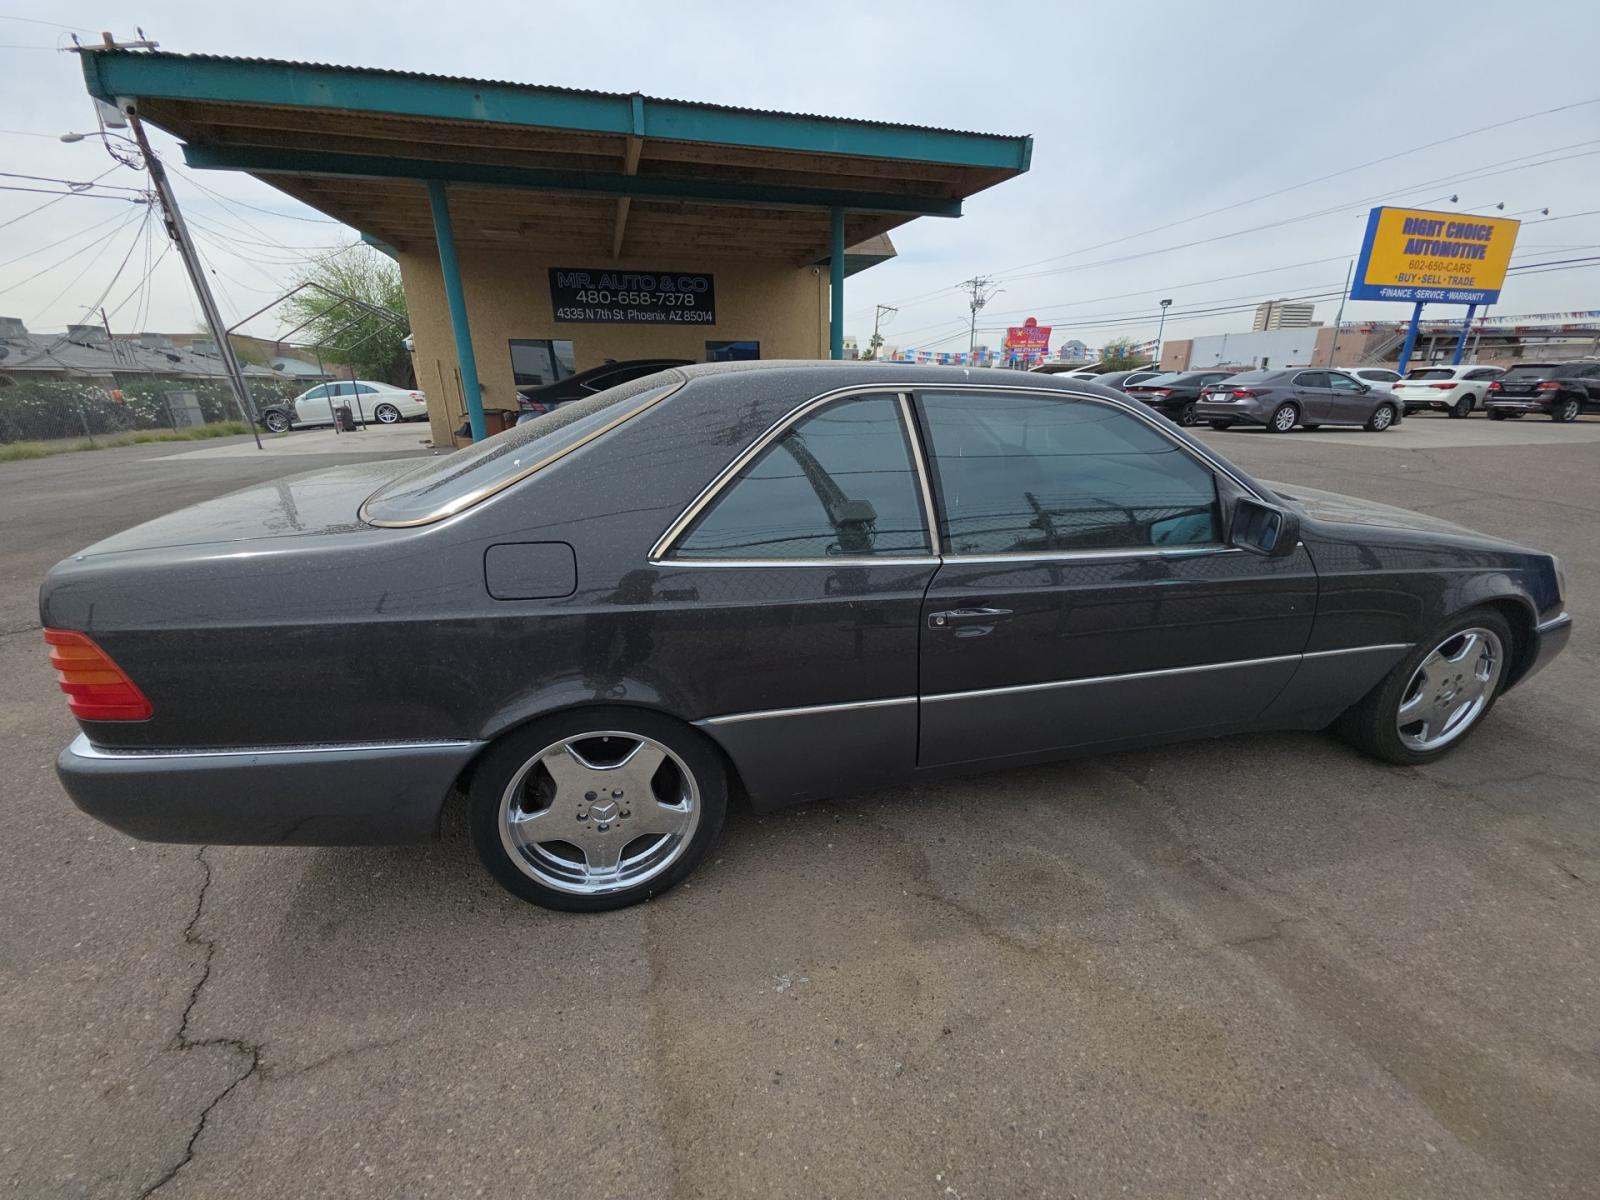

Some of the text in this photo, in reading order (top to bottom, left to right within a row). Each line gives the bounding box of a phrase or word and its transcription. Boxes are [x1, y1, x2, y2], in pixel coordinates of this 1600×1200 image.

[1402, 217, 1495, 241] RIGHT CHOICE
[1403, 238, 1488, 260] AUTOMOTIVE
[1408, 260, 1472, 275] 602-650-CARS
[558, 272, 709, 293] MR. AUTO & CO
[1397, 272, 1476, 286] BUY SELL TRADE
[576, 290, 695, 306] 480-658-7378
[1381, 288, 1485, 301] FINANCE SERVICE WARRANTY
[557, 308, 713, 322] 4335 N 7th St Phoenix AZ 85014
